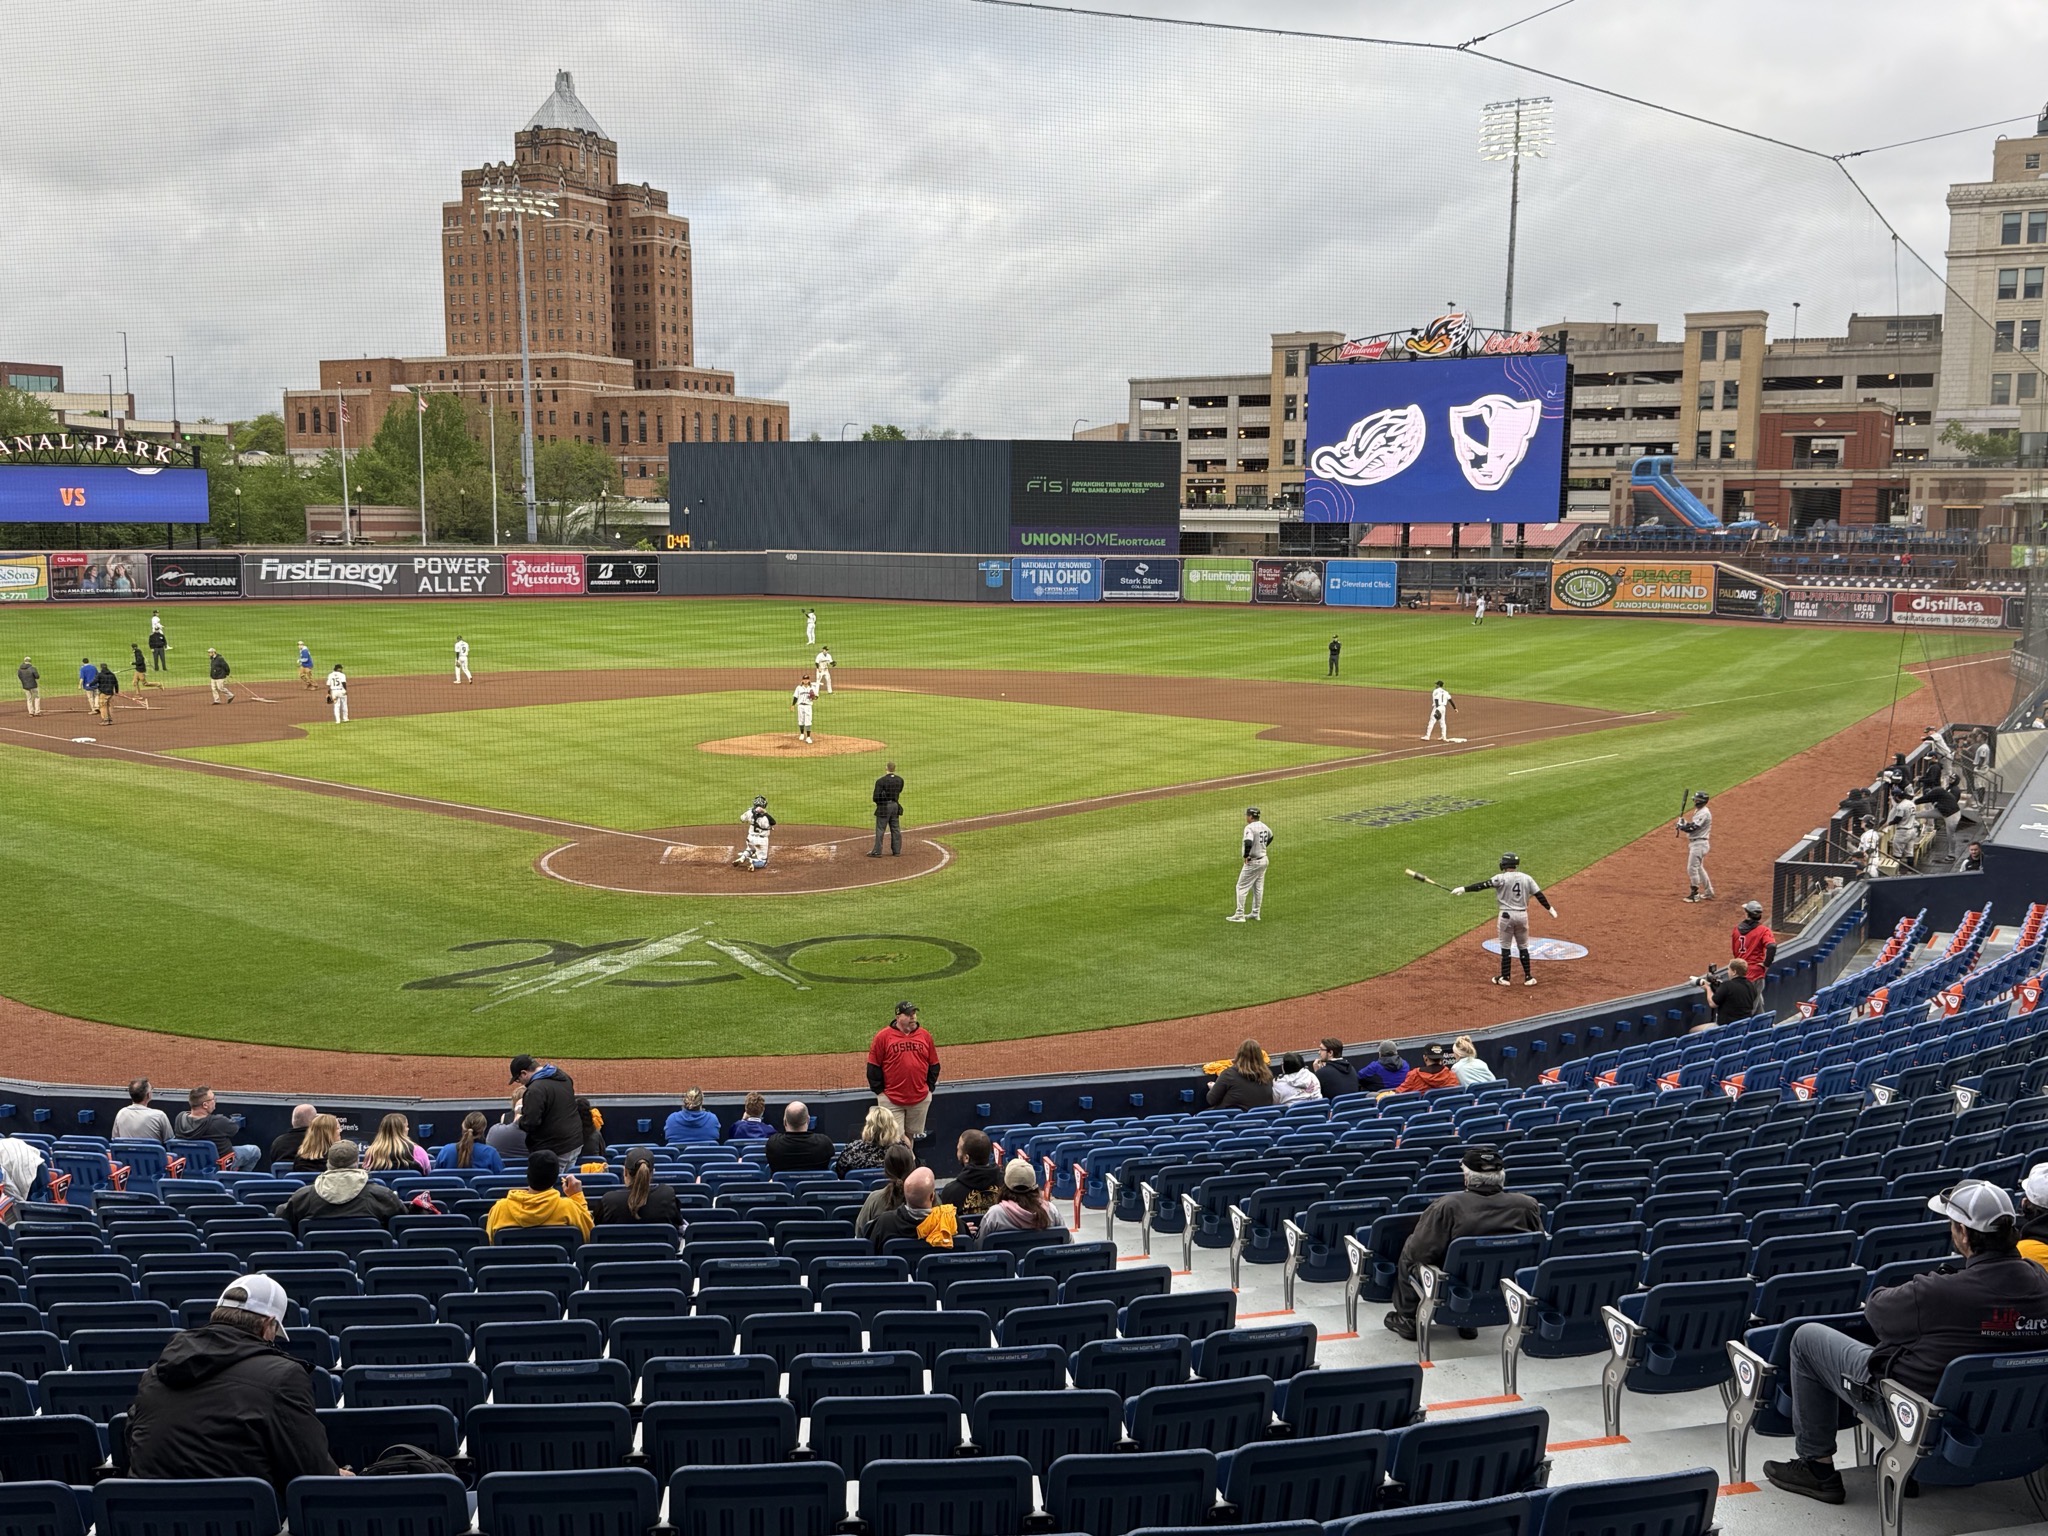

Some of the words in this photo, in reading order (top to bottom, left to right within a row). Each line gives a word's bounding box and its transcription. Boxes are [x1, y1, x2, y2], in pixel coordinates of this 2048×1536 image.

[1343, 344, 1384, 358] Budweiser
[95, 434, 172, 464] PARK
[59, 487, 86, 507] VS
[667, 534, 691, 549] 0:49
[413, 557, 491, 574] POWER
[512, 560, 576, 574] Stadium
[185, 577, 236, 587] MORGAN
[512, 572, 580, 588] Mustard
[1022, 570, 1036, 584] #1
[1039, 570, 1054, 584] IN
[1056, 570, 1092, 584] OHIO
[1201, 570, 1251, 584] Huntington
[1560, 569, 1588, 584] PLUMBING
[1590, 570, 1612, 586] HEATING
[1632, 569, 1692, 584] PEACE
[418, 576, 488, 593] ALLEY
[1342, 580, 1373, 588] Cleveland
[1374, 580, 1392, 588] Clinic
[1632, 584, 1657, 598] OF
[1660, 585, 1708, 600] MIND
[1560, 592, 1581, 607] COOLING
[1586, 593, 1611, 607] ELECTRIC
[1614, 601, 1708, 611] JANDJPLUMBING.COM
[1911, 596, 1984, 612] distillata
[1854, 604, 1876, 612] LOCAL
[1896, 615, 1941, 623] distillata.com
[332, 678, 340, 687] 15
[1512, 882, 1522, 896] 4
[1738, 936, 1746, 953] 1
[892, 1041, 924, 1054] USHER
